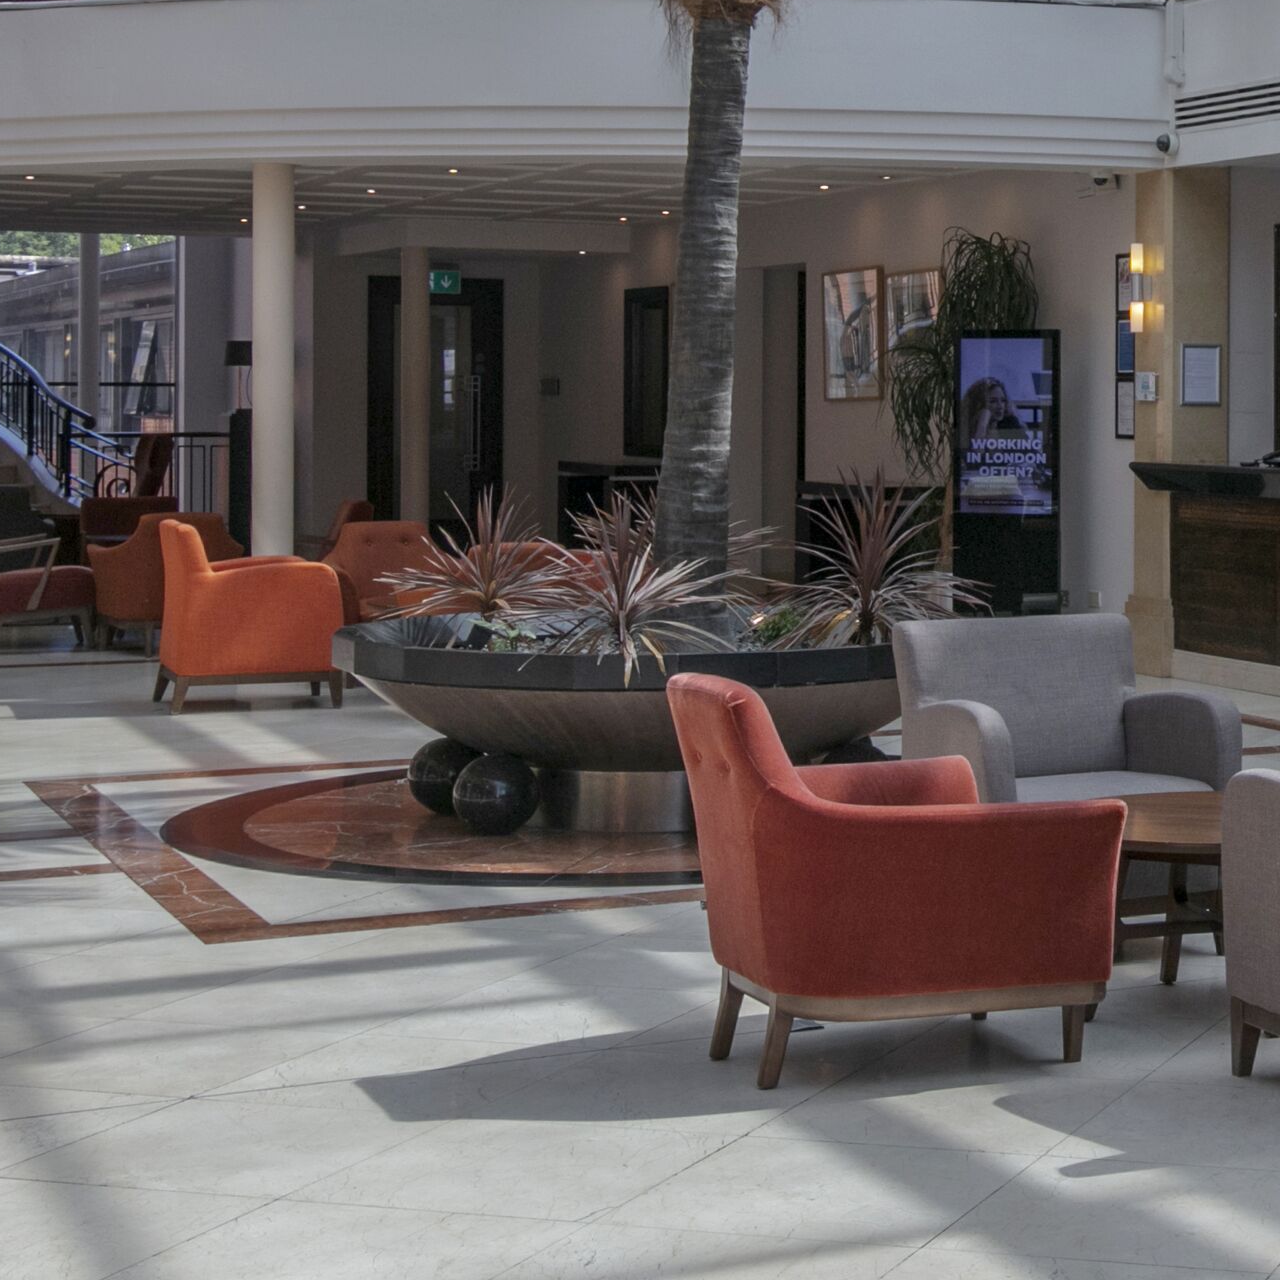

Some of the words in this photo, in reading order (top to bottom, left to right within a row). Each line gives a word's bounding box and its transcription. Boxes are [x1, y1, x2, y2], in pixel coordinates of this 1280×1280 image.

[971, 438, 1042, 450] WORKING
[966, 452, 981, 463] IN
[985, 452, 1046, 464] LONDON
[979, 466, 1034, 478] OFTEN?
